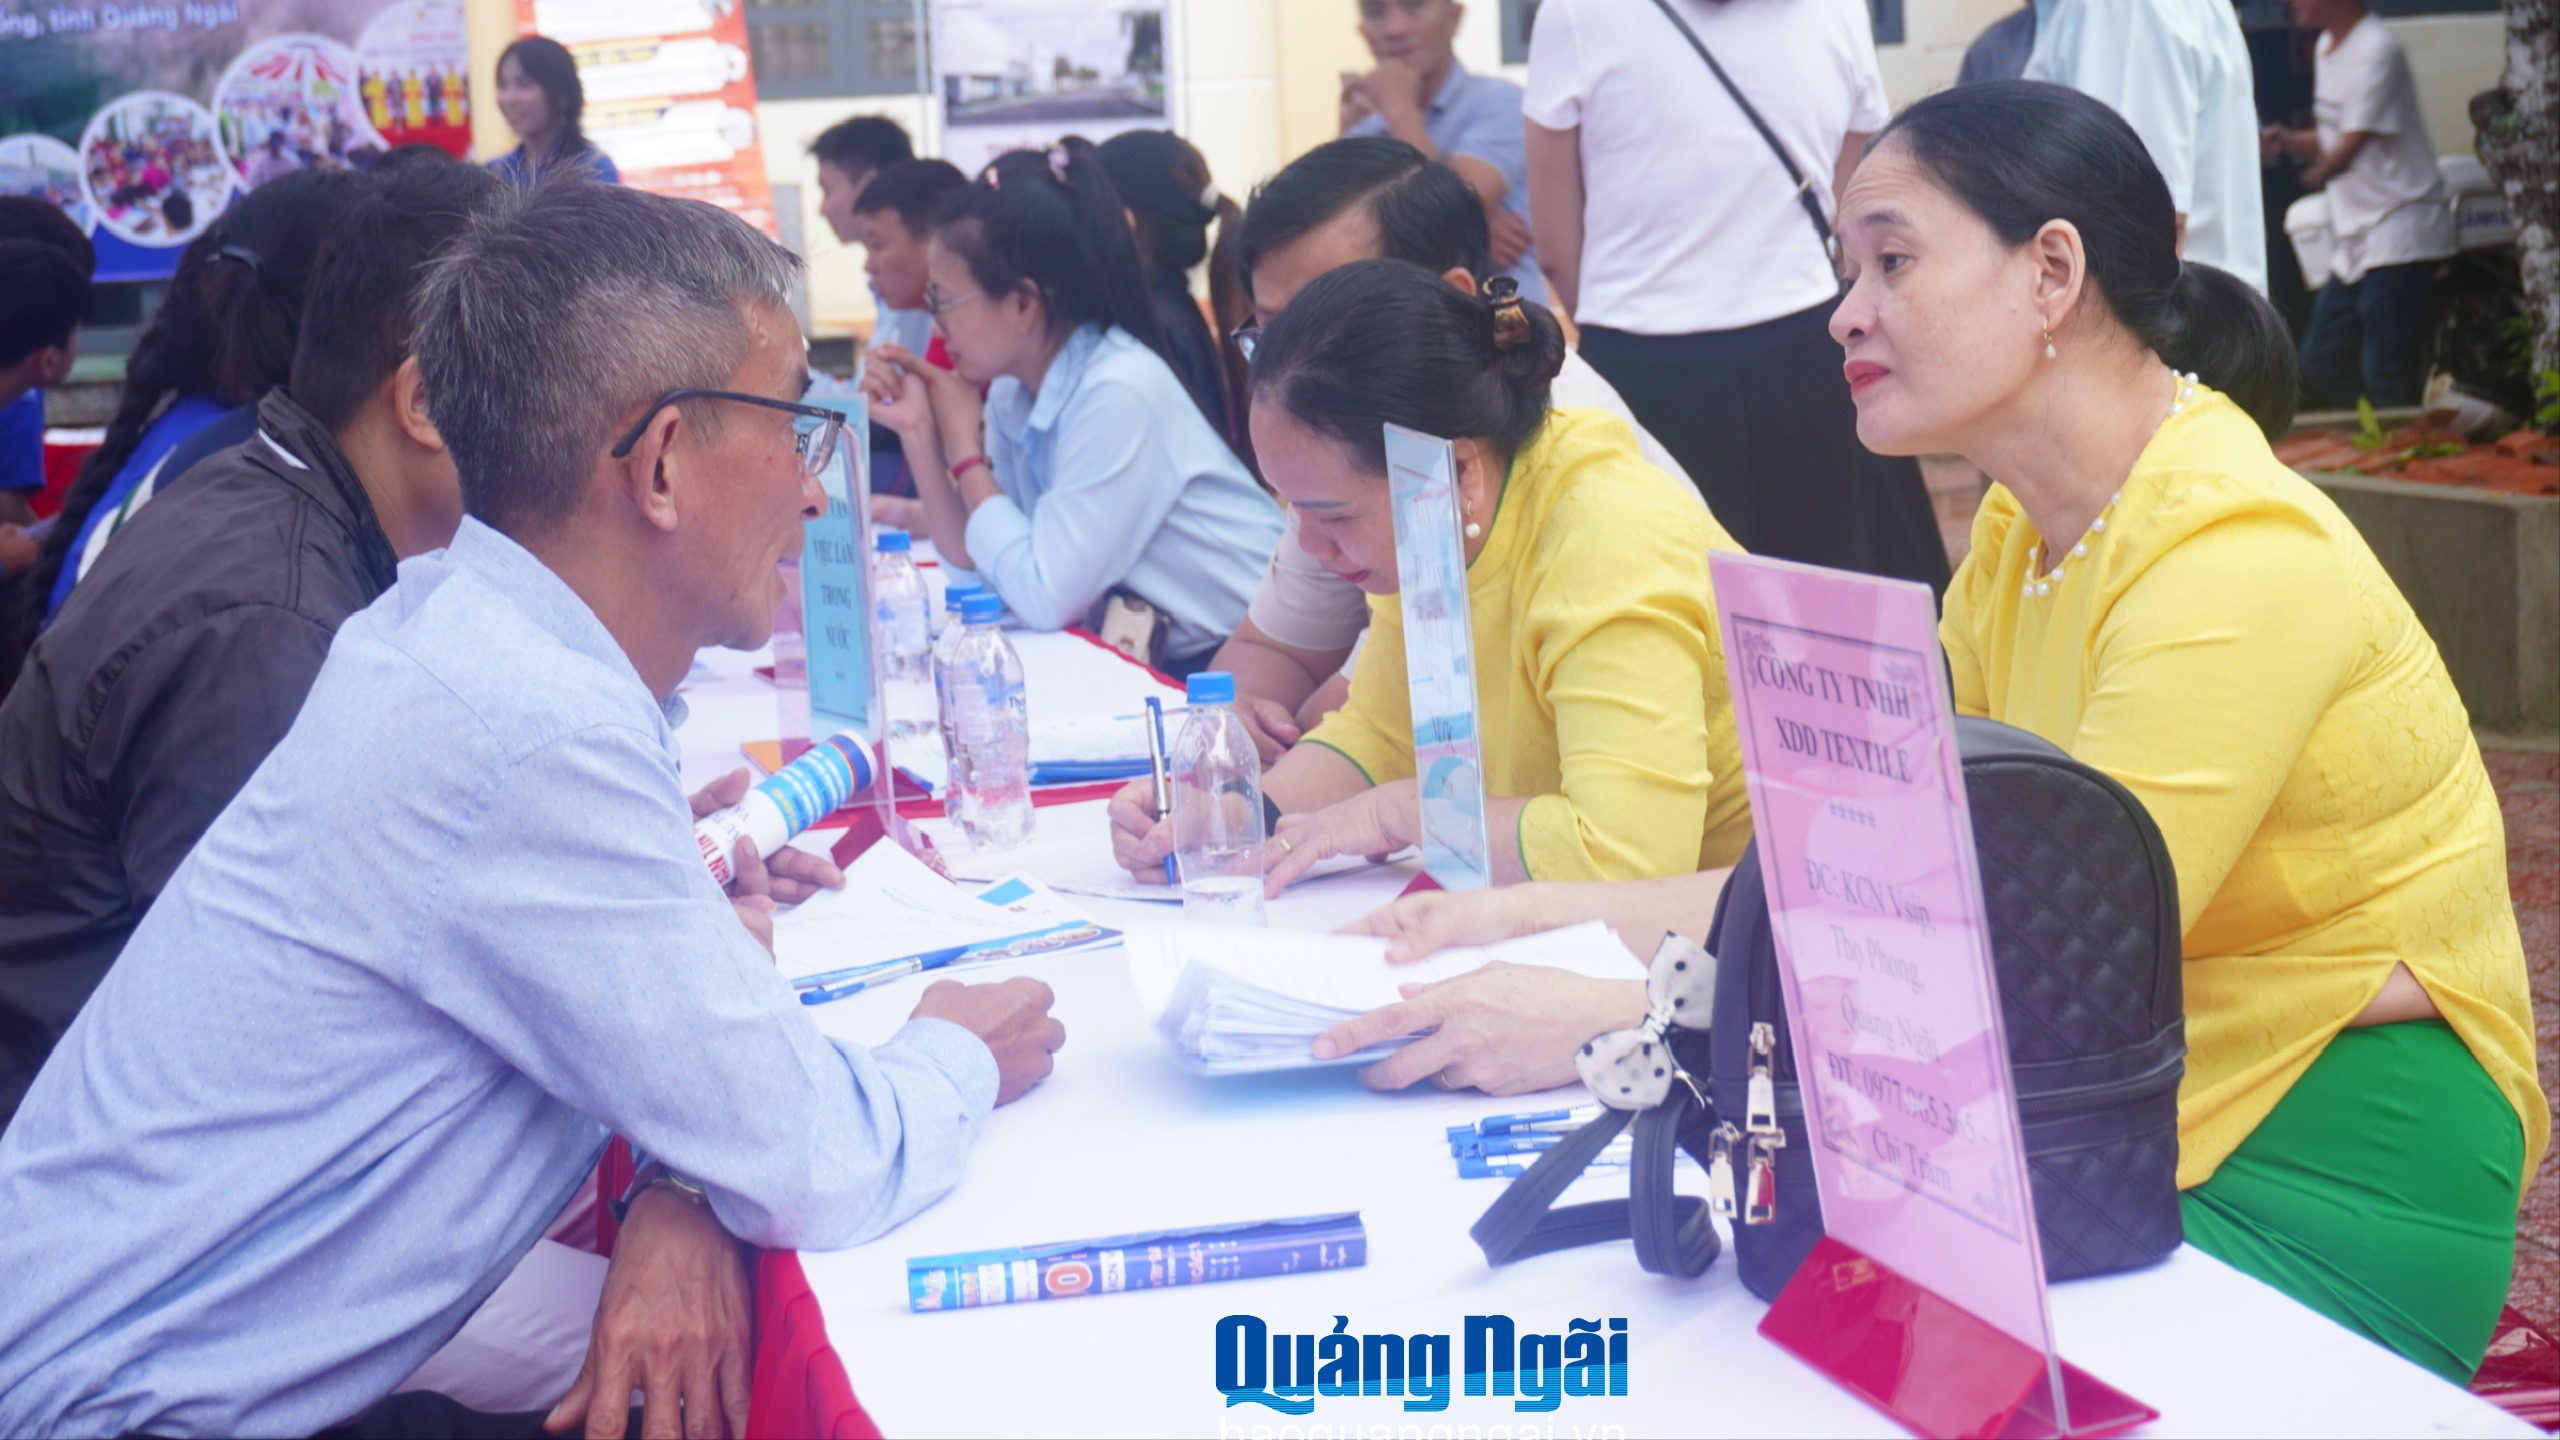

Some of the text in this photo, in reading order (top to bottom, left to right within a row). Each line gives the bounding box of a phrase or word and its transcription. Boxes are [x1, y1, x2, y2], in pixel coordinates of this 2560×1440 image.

[821, 584, 852, 609] TRONG
[825, 622, 850, 650] NƯỚC
[1815, 667, 1844, 704] TY
[1847, 675, 1912, 719] TNHH
[1775, 716, 1913, 784] XDD TEXTILE
[1804, 857, 1840, 899] ĐC:
[1842, 869, 1886, 913] KCN
